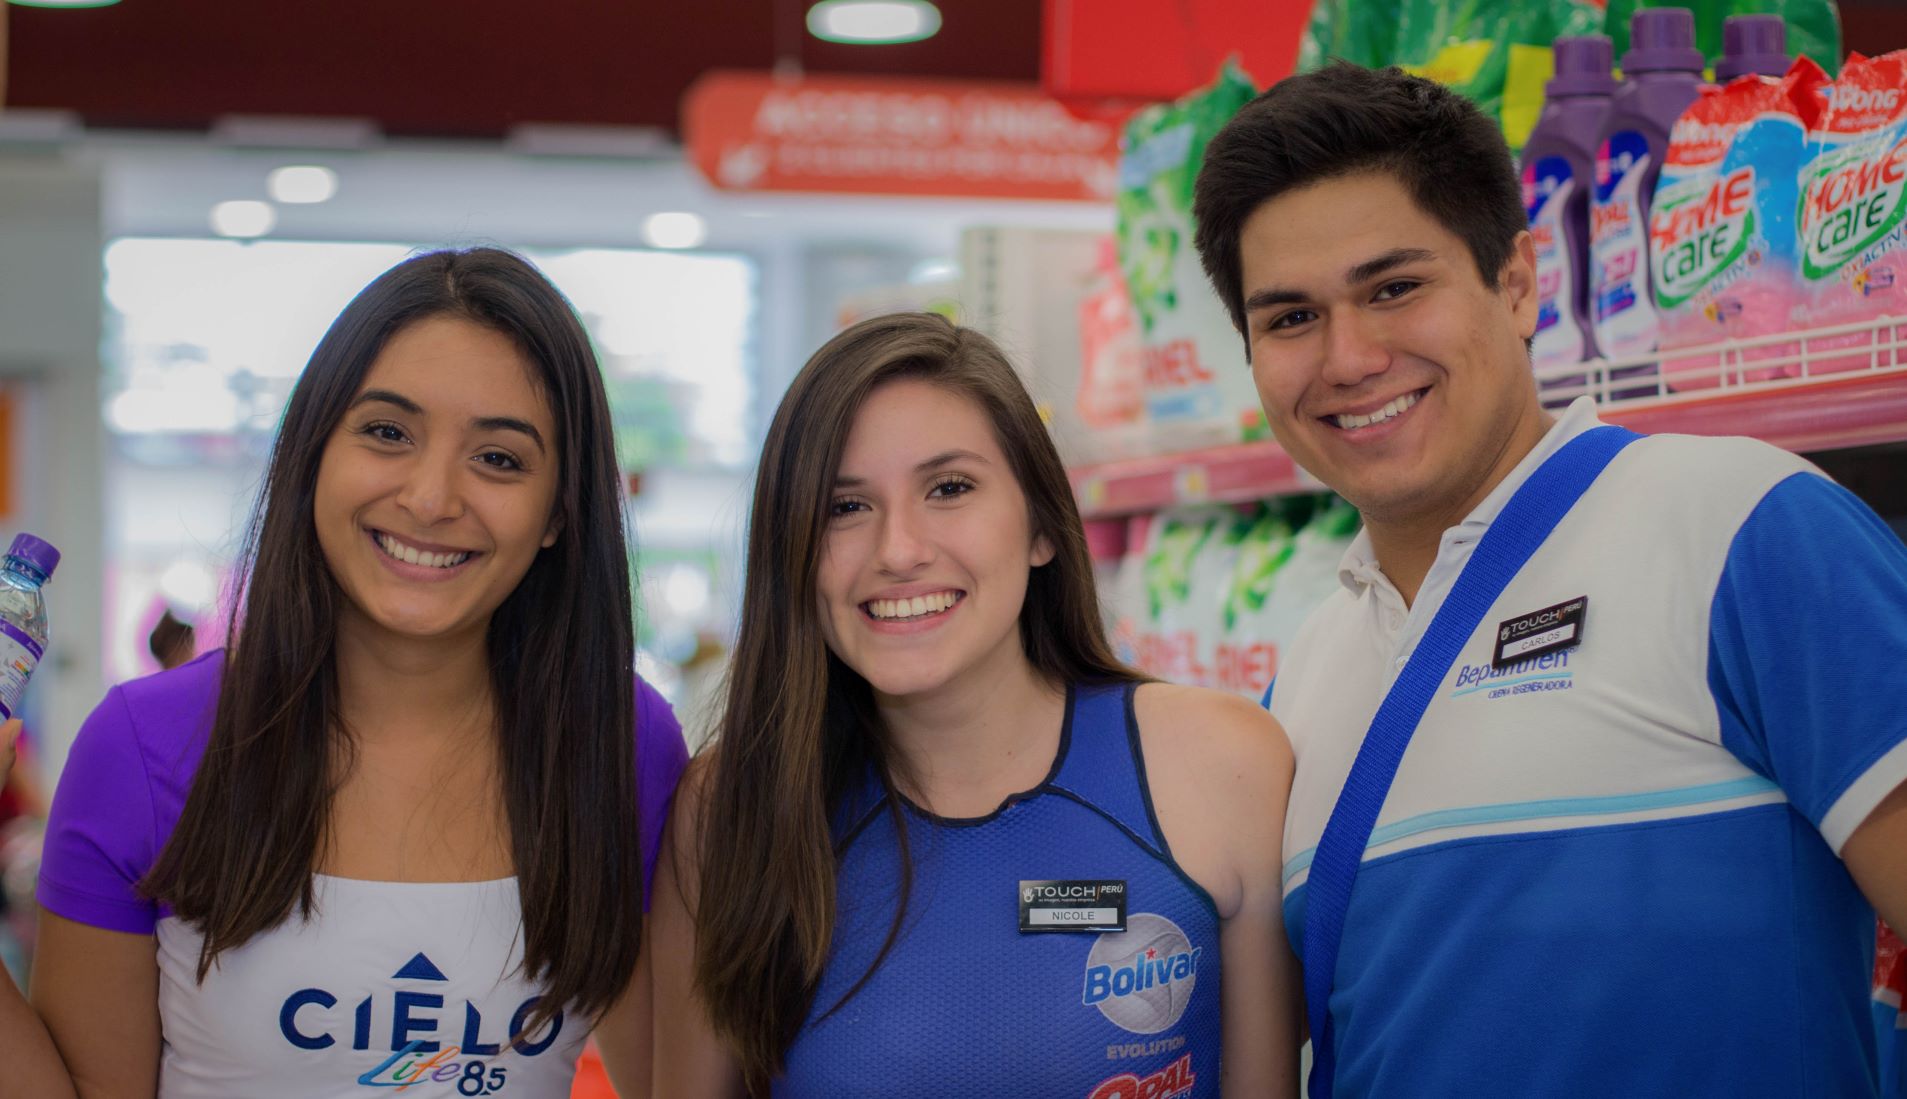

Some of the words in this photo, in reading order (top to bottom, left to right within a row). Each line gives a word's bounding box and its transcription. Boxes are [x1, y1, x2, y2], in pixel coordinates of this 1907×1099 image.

[1651, 169, 1752, 251] HME
[1510, 609, 1561, 633] TOUCH
[1521, 630, 1561, 650] CARLOS
[1034, 886, 1096, 898] TOUCH
[1100, 883, 1124, 894] PERÚ
[1051, 911, 1095, 921] NICOLE
[1083, 947, 1202, 1005] Bolivar
[279, 986, 564, 1057] CIELO
[357, 1039, 462, 1093] Life
